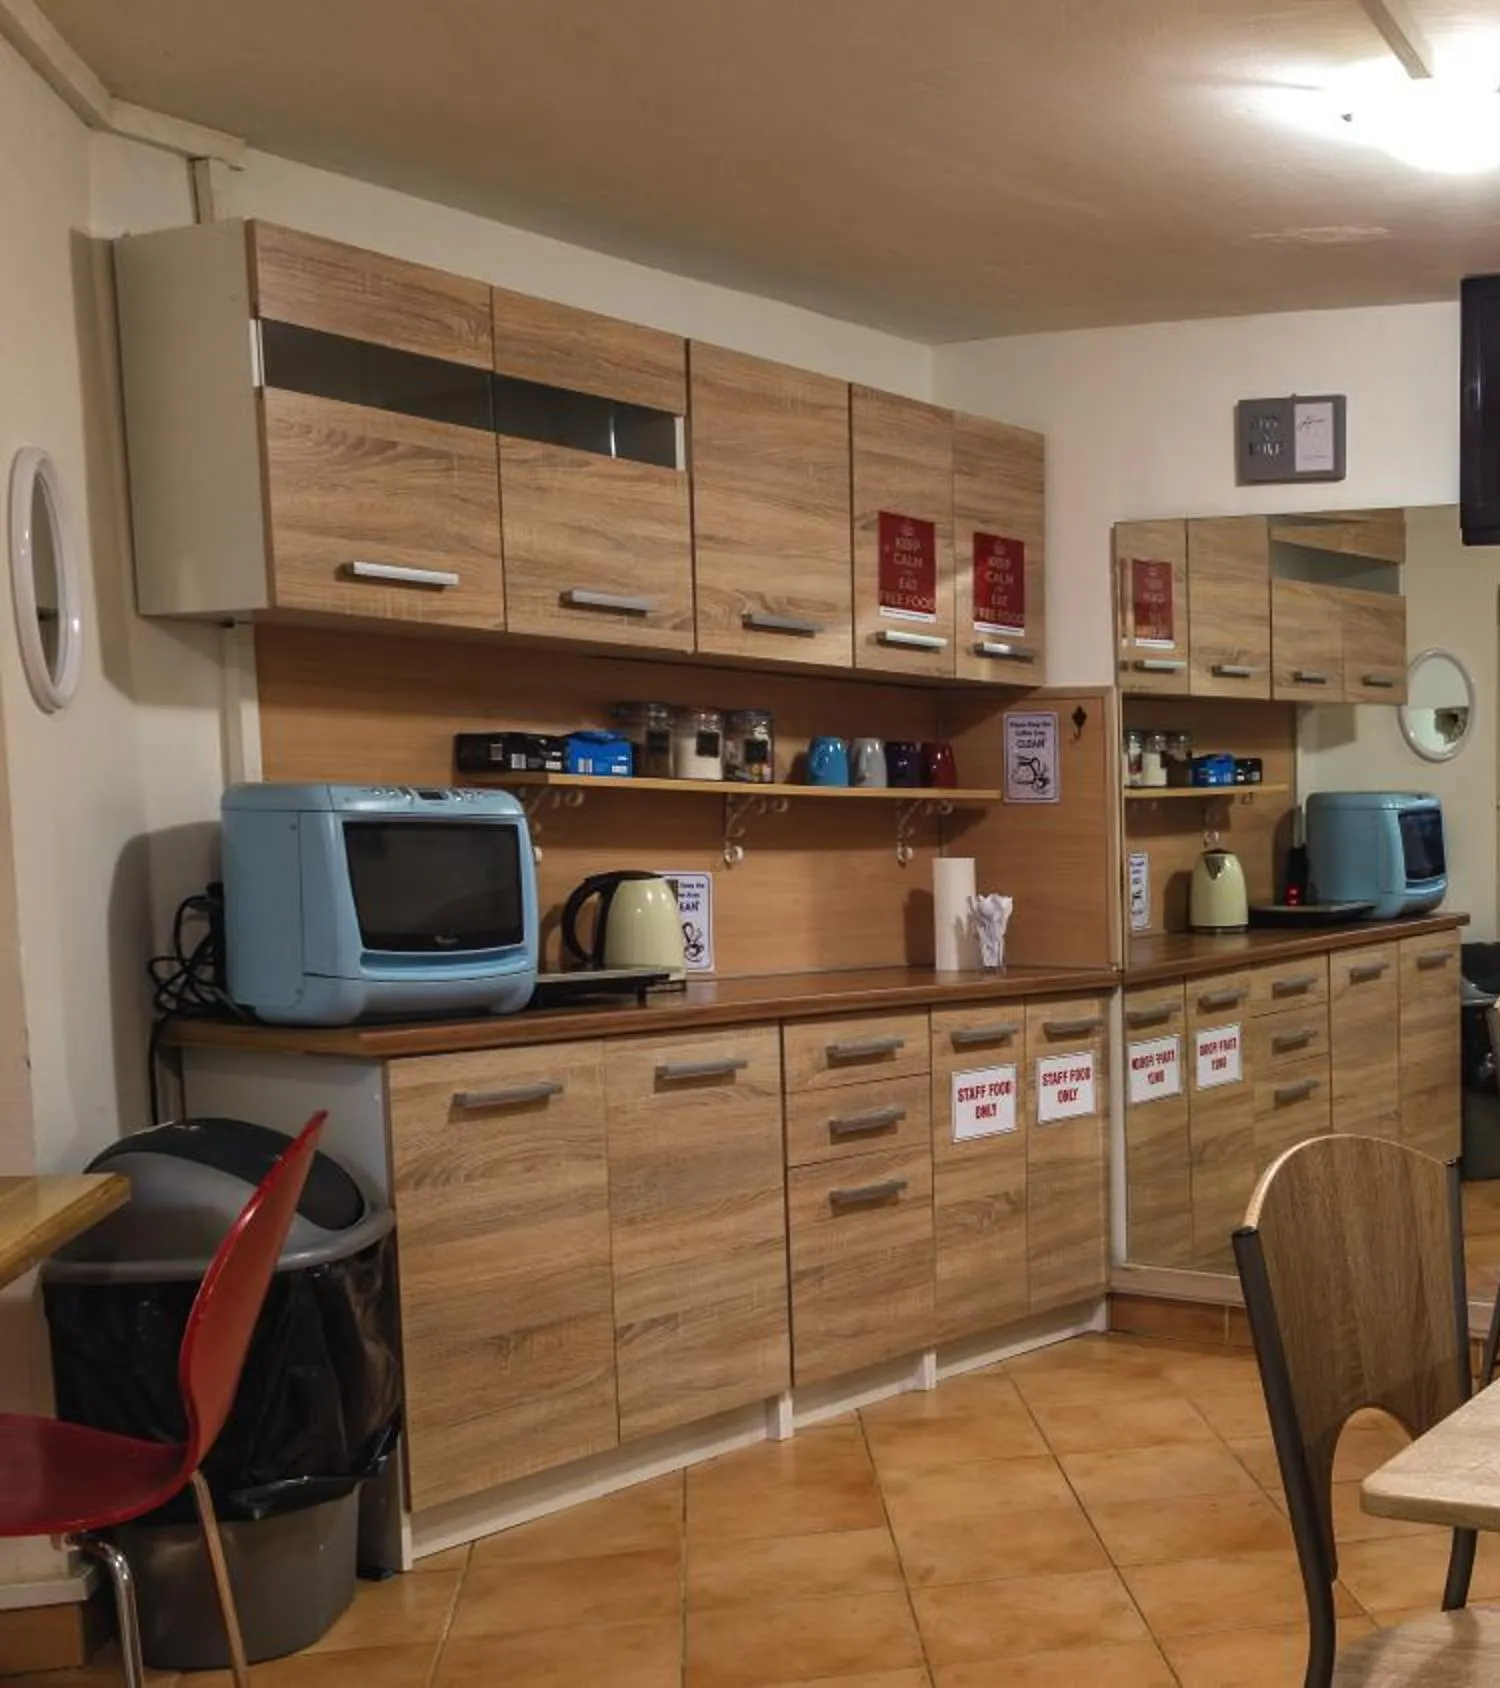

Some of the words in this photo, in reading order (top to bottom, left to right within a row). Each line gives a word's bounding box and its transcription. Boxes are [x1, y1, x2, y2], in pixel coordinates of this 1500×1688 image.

[893, 553, 923, 568] CALM
[985, 571, 1014, 584] CALM
[1042, 1071, 1068, 1086] STAFF
[1070, 1066, 1091, 1081] FOOD
[957, 1083, 986, 1103] STAFF
[988, 1080, 1012, 1097] FOOD
[1057, 1088, 1079, 1104] ONLY
[975, 1103, 997, 1120] ONLY
